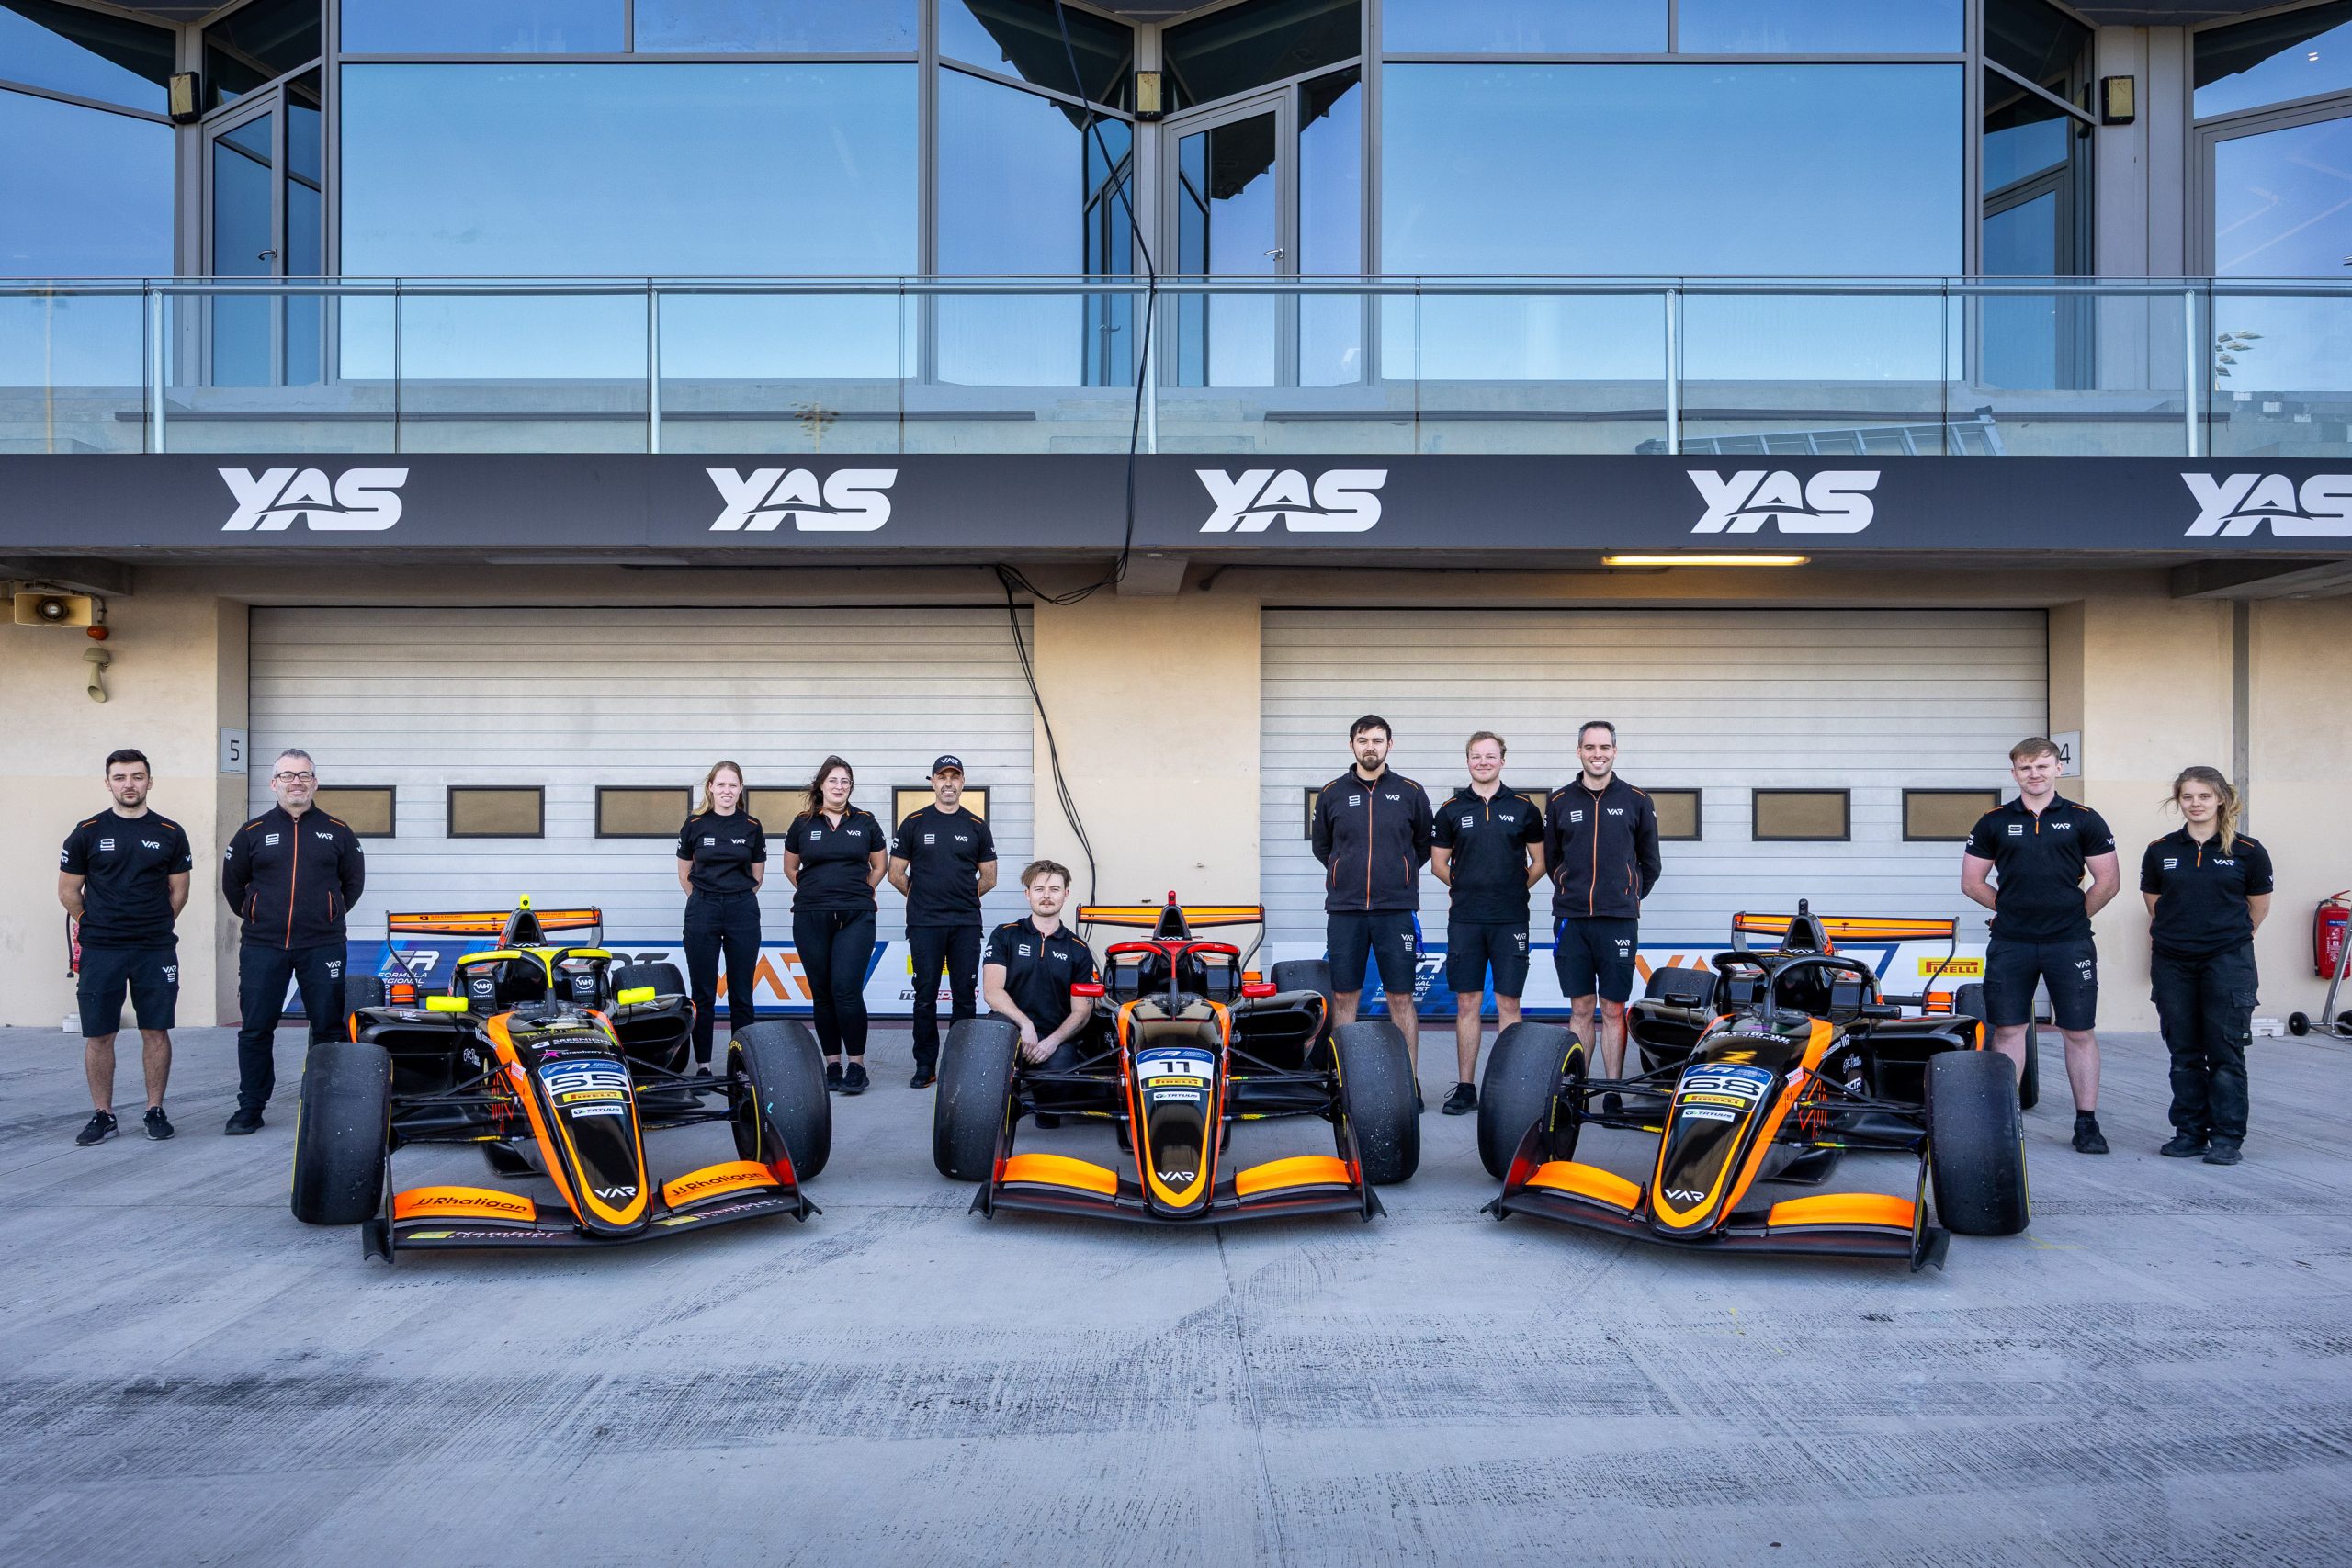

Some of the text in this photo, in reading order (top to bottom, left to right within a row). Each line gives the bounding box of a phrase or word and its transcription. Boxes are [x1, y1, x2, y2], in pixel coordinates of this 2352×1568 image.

[219, 468, 409, 530] YAS
[706, 468, 898, 531] YAS
[1195, 470, 1387, 532] YAS
[1687, 470, 1880, 533] YAS
[231, 739, 239, 761] 5
[2060, 743, 2071, 764] 4
[1385, 793, 1401, 801] VAR
[1498, 814, 1515, 823] VAR
[315, 831, 334, 840] VAR
[955, 834, 968, 842] VAR
[141, 840, 160, 850] VAR
[2213, 858, 2235, 866] VAR
[1401, 933, 1414, 942] VAR
[1513, 932, 1527, 941] VAR
[1052, 950, 1068, 961] VAR
[162, 964, 177, 974] VAR
[325, 960, 342, 969] VAR
[1926, 962, 1978, 973] PIRELLI
[2074, 959, 2091, 969] VAR
[1159, 1061, 1191, 1073] 11
[551, 1074, 627, 1092] 55
[1683, 1077, 1760, 1096] 68
[1157, 1171, 1195, 1182] VAR
[594, 1186, 637, 1199] VAR
[1664, 1189, 1705, 1202] VAR
